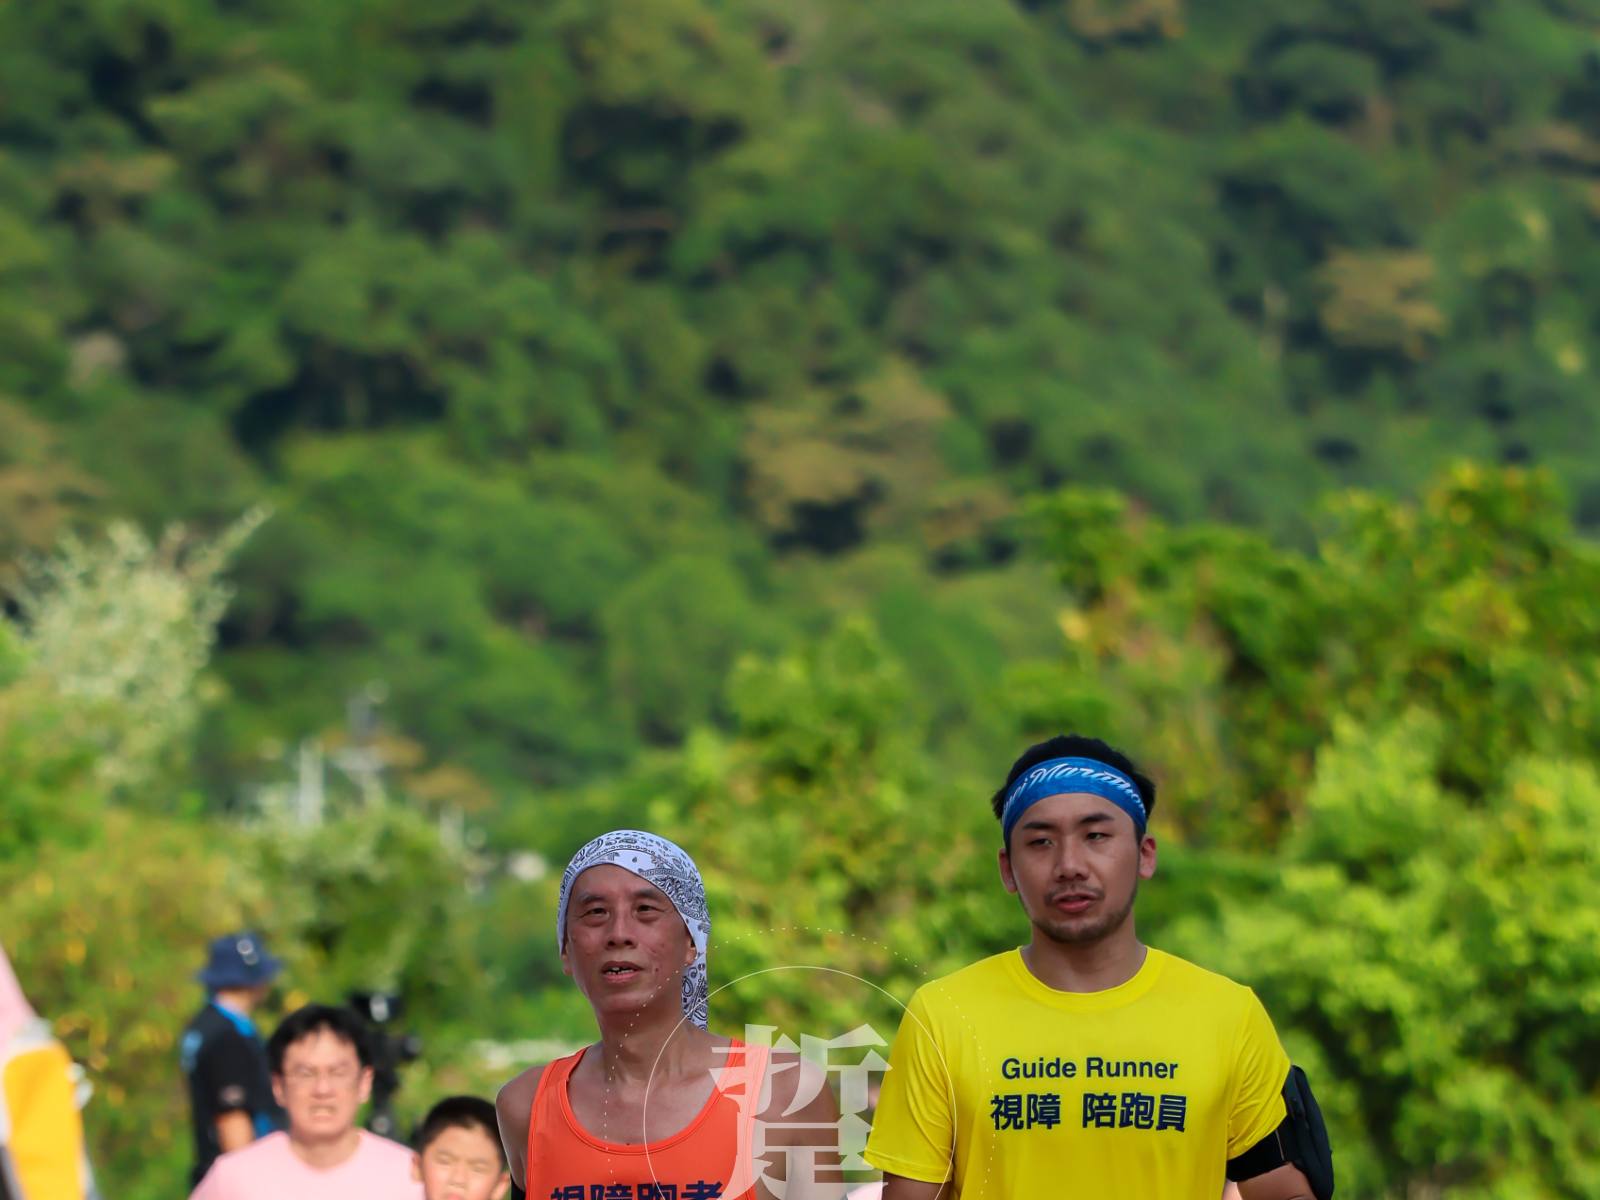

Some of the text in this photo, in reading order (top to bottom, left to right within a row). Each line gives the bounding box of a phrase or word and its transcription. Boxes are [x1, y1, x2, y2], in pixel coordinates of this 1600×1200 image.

[1001, 1057, 1179, 1080] Guide Runner
[990, 1092, 1187, 1133] 視障 陪跑員
